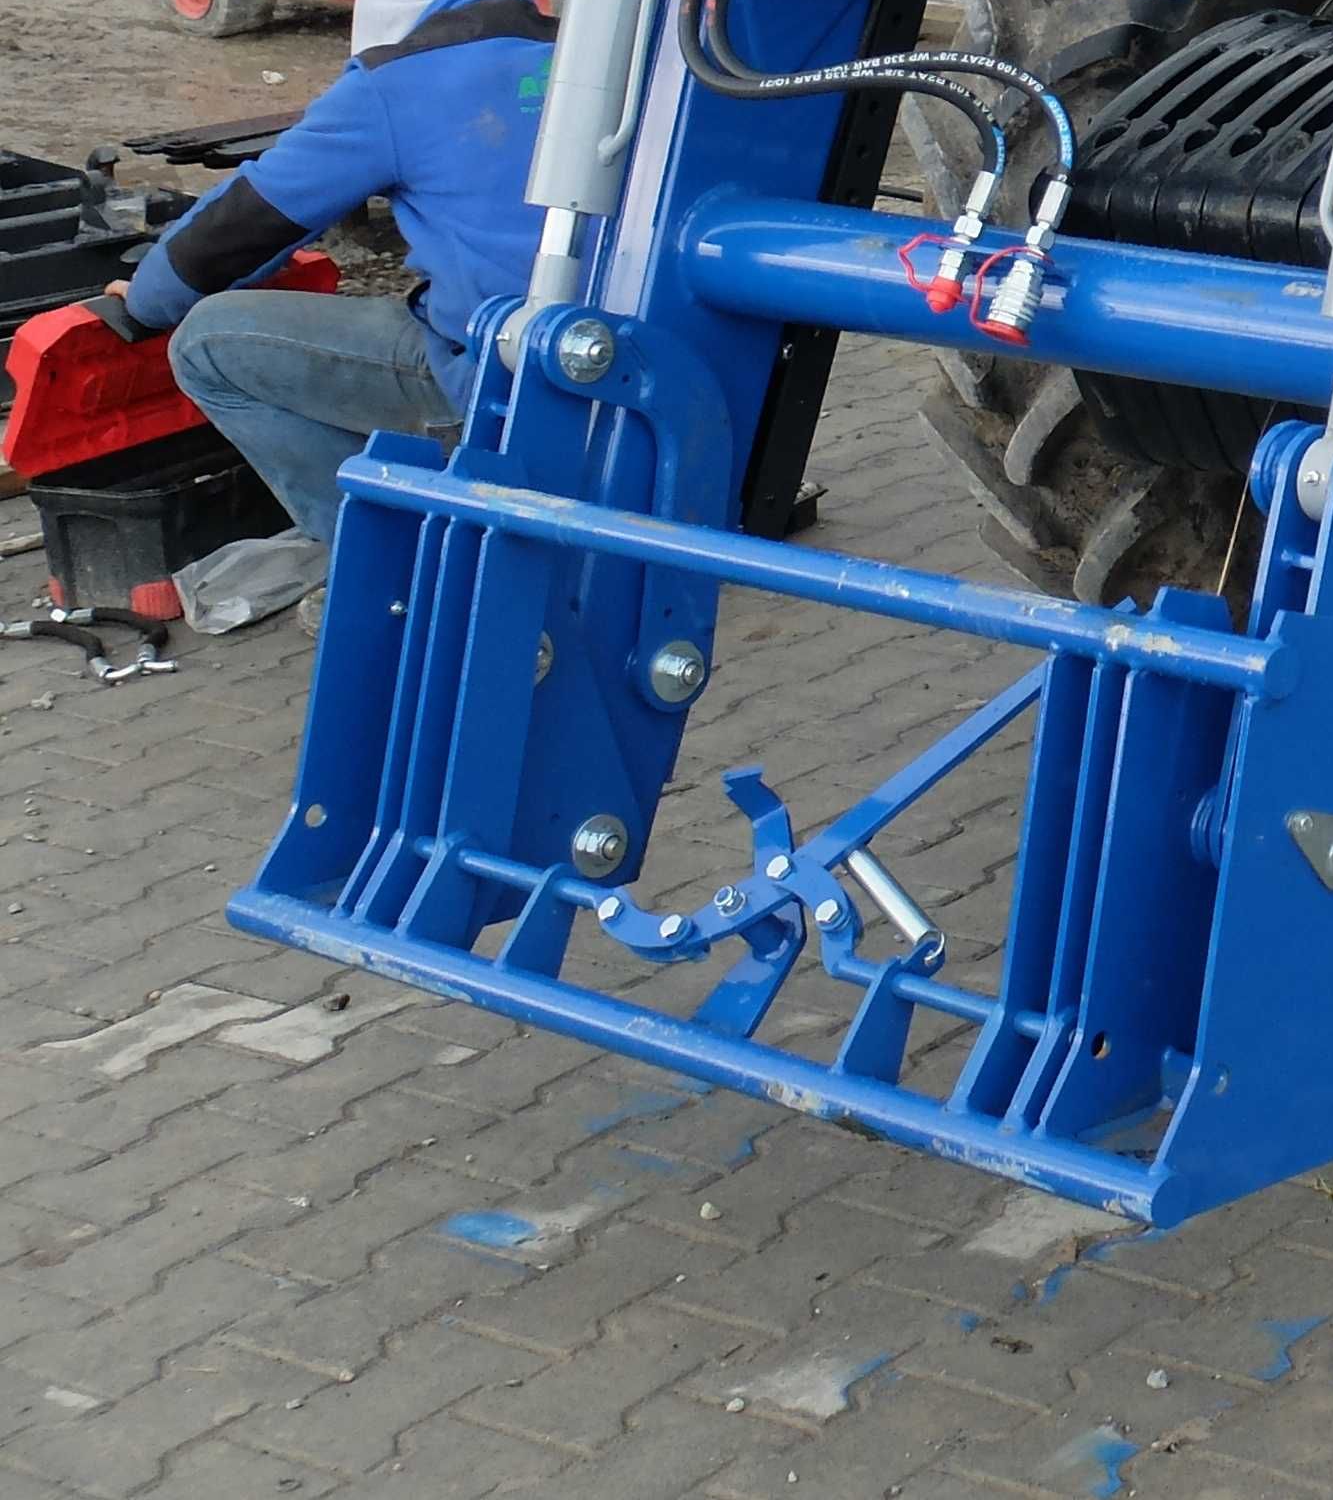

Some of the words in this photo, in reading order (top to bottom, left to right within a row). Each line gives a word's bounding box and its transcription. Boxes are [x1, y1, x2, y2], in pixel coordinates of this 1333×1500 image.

[960, 53, 994, 68] R2AT
[995, 61, 1018, 77] 100
[1018, 71, 1045, 93] SAE
